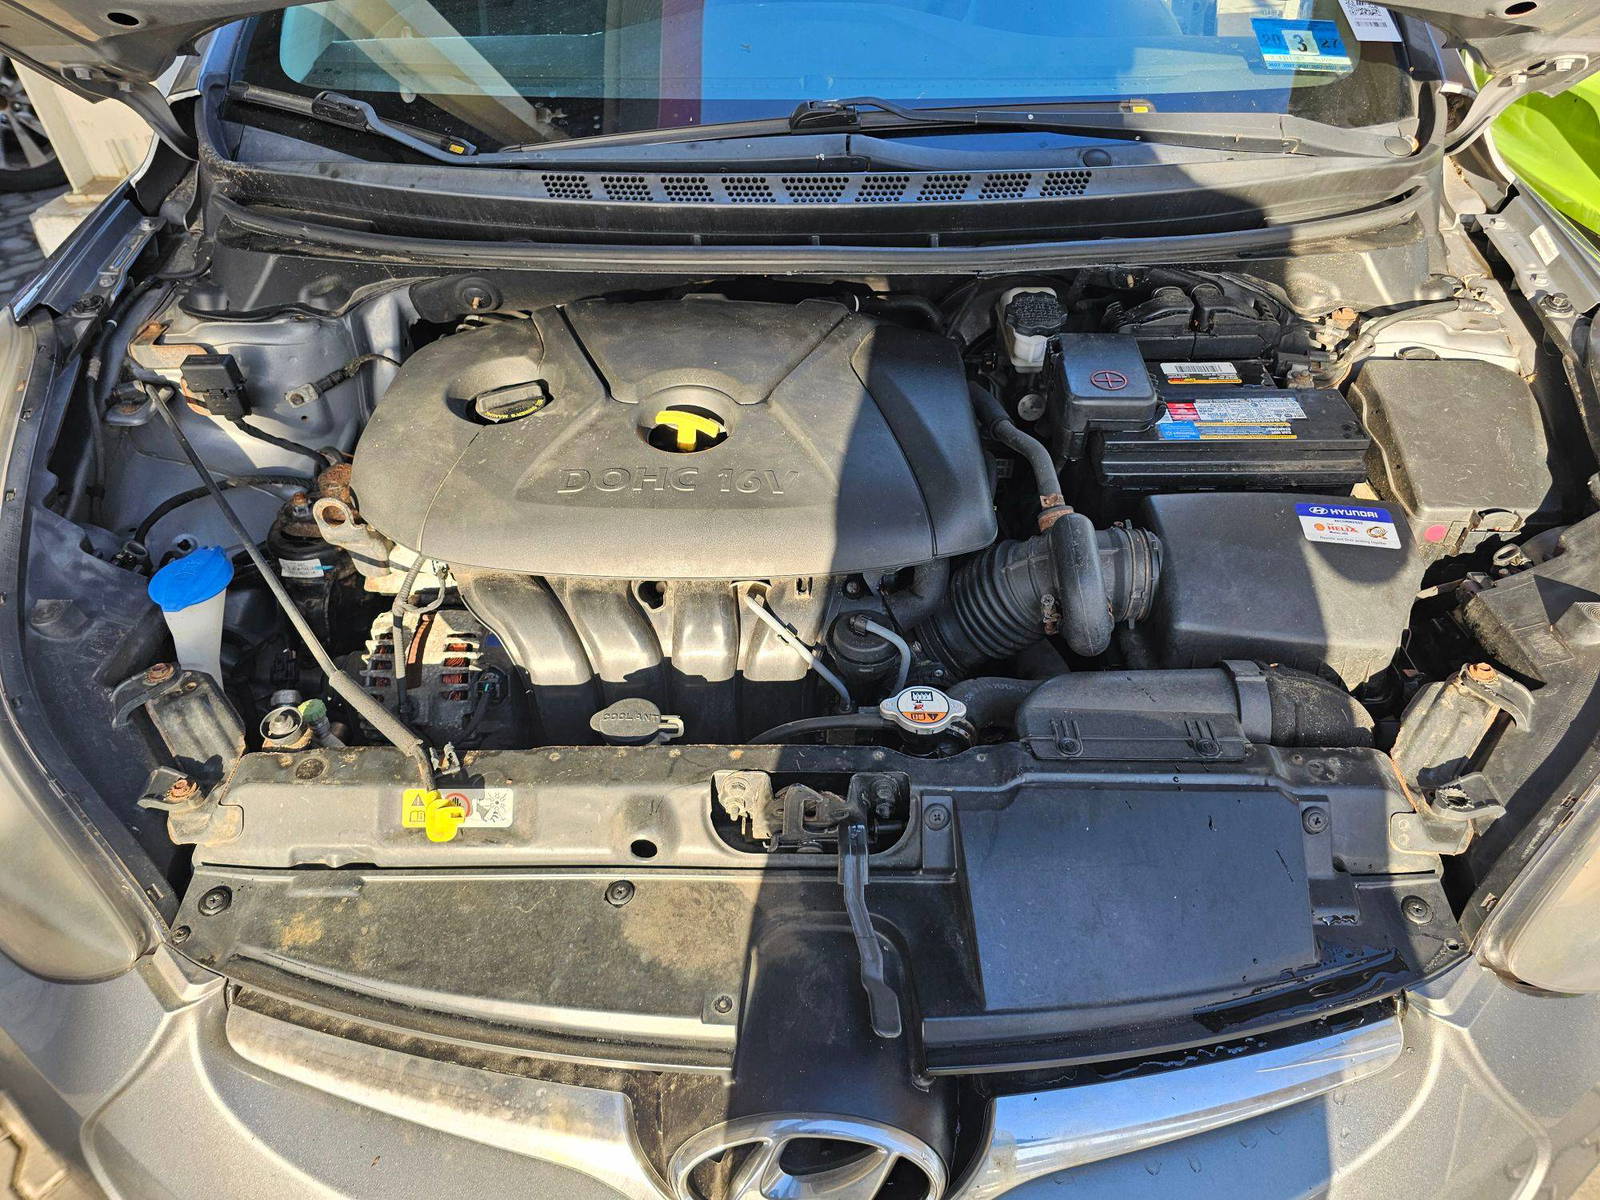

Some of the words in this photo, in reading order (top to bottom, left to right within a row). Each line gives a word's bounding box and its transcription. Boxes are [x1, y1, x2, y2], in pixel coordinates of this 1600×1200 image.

[1262, 33, 1280, 45] 20
[1293, 34, 1308, 52] 3
[1320, 39, 1339, 49] 27
[557, 467, 699, 493] DOHC
[718, 468, 799, 494] 16V
[1330, 508, 1378, 519] HYUNDAI
[1327, 525, 1359, 534] HELIX
[603, 711, 659, 722] COOLANT
